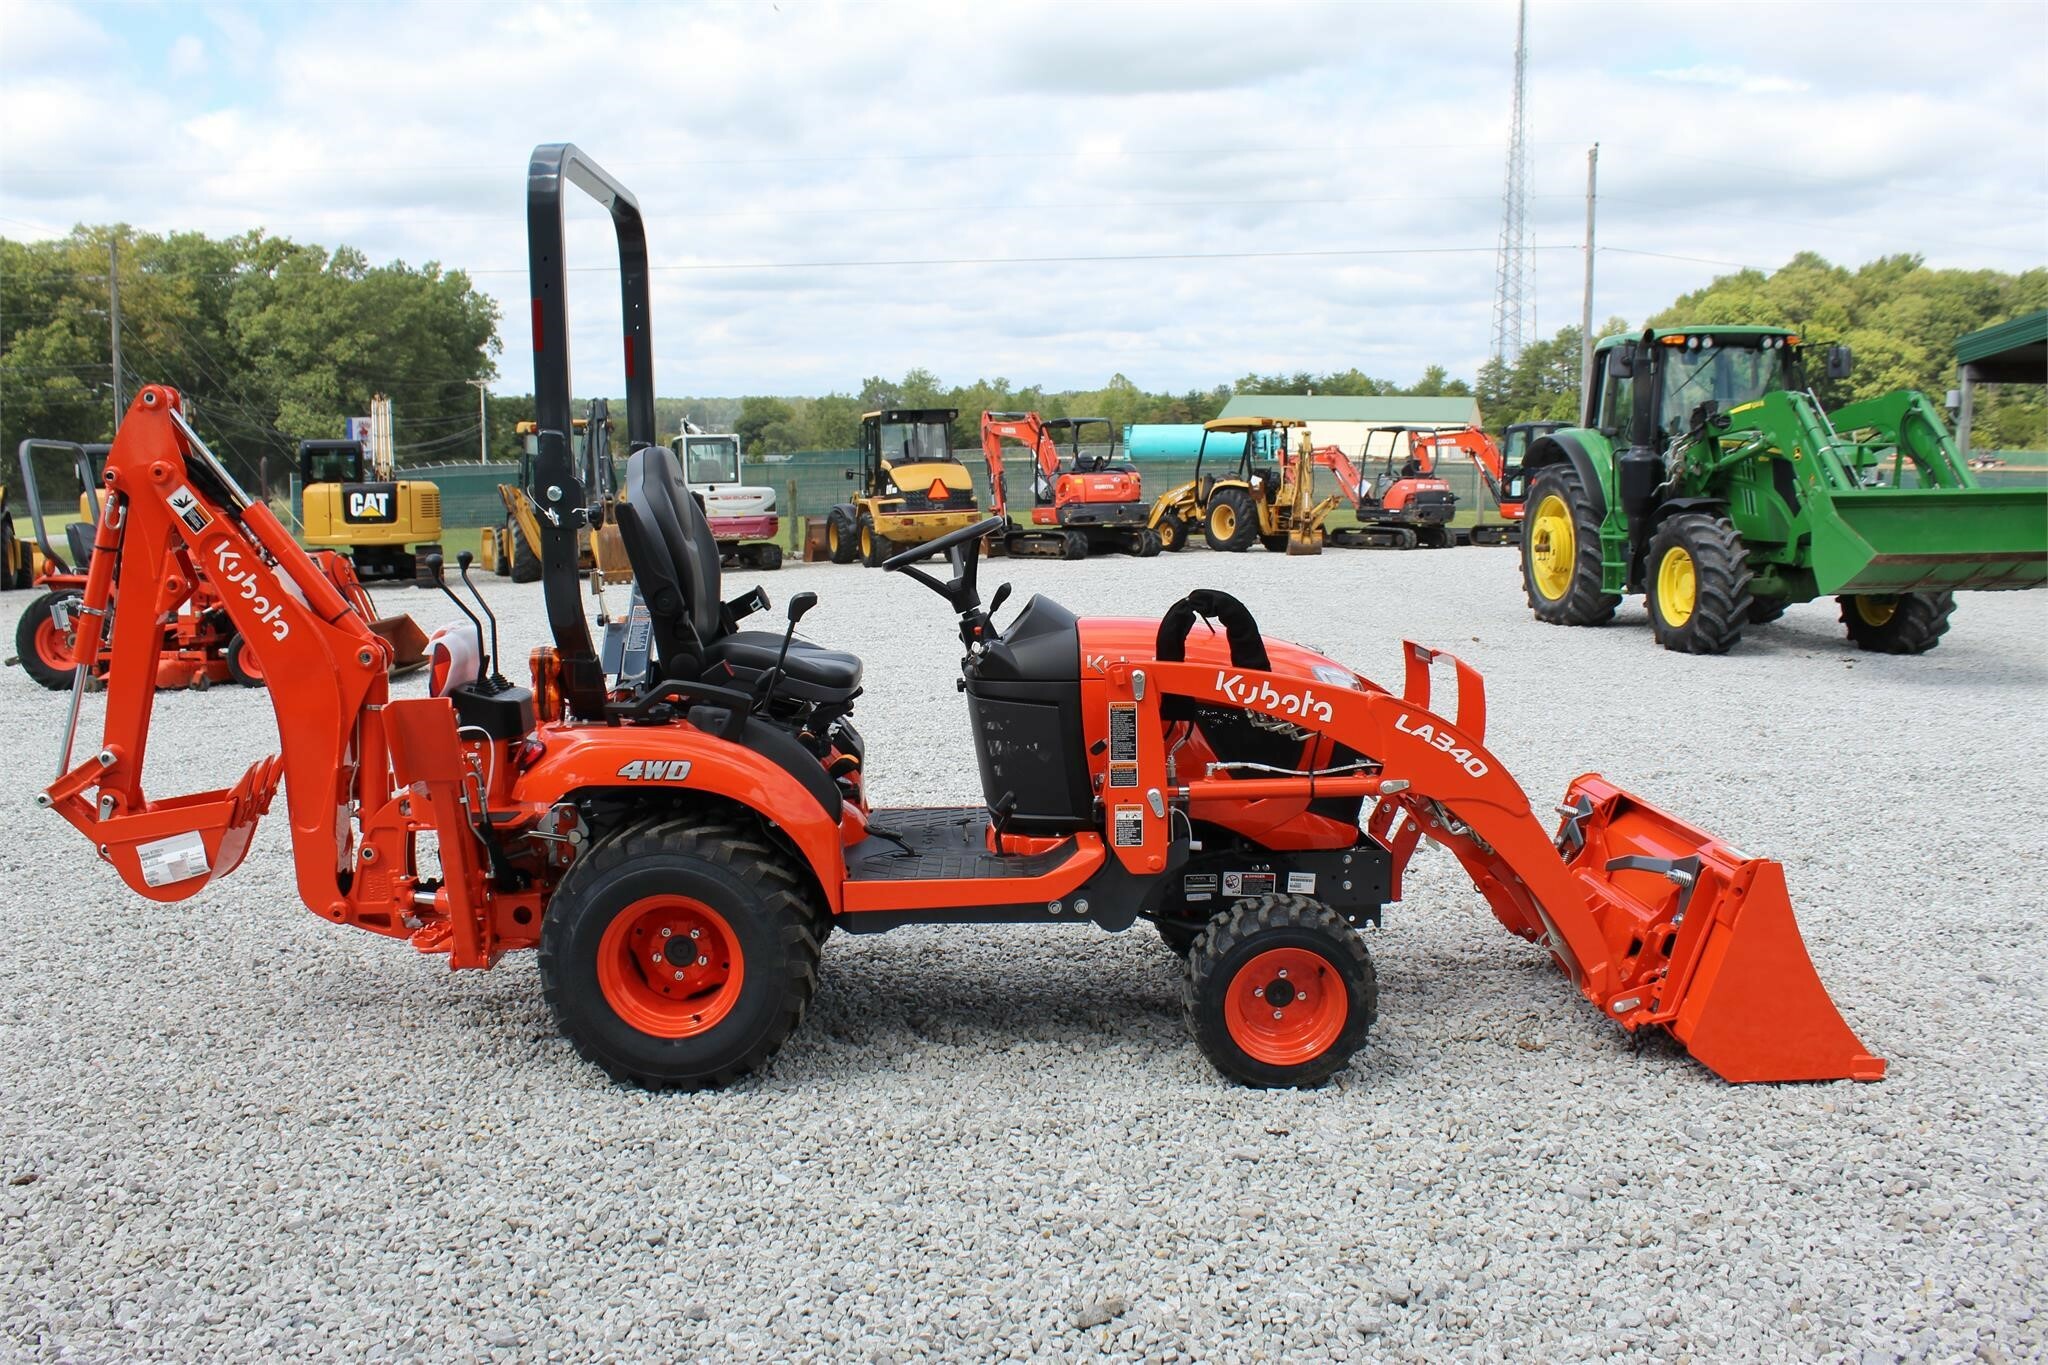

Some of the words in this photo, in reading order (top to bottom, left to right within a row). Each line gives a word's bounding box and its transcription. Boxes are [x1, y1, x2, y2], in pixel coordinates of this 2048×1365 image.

[350, 492, 389, 517] CAT
[213, 539, 290, 642] Kubota
[1215, 670, 1333, 723] Kubota
[616, 760, 692, 781] 4WD
[1394, 713, 1489, 778] LA340
